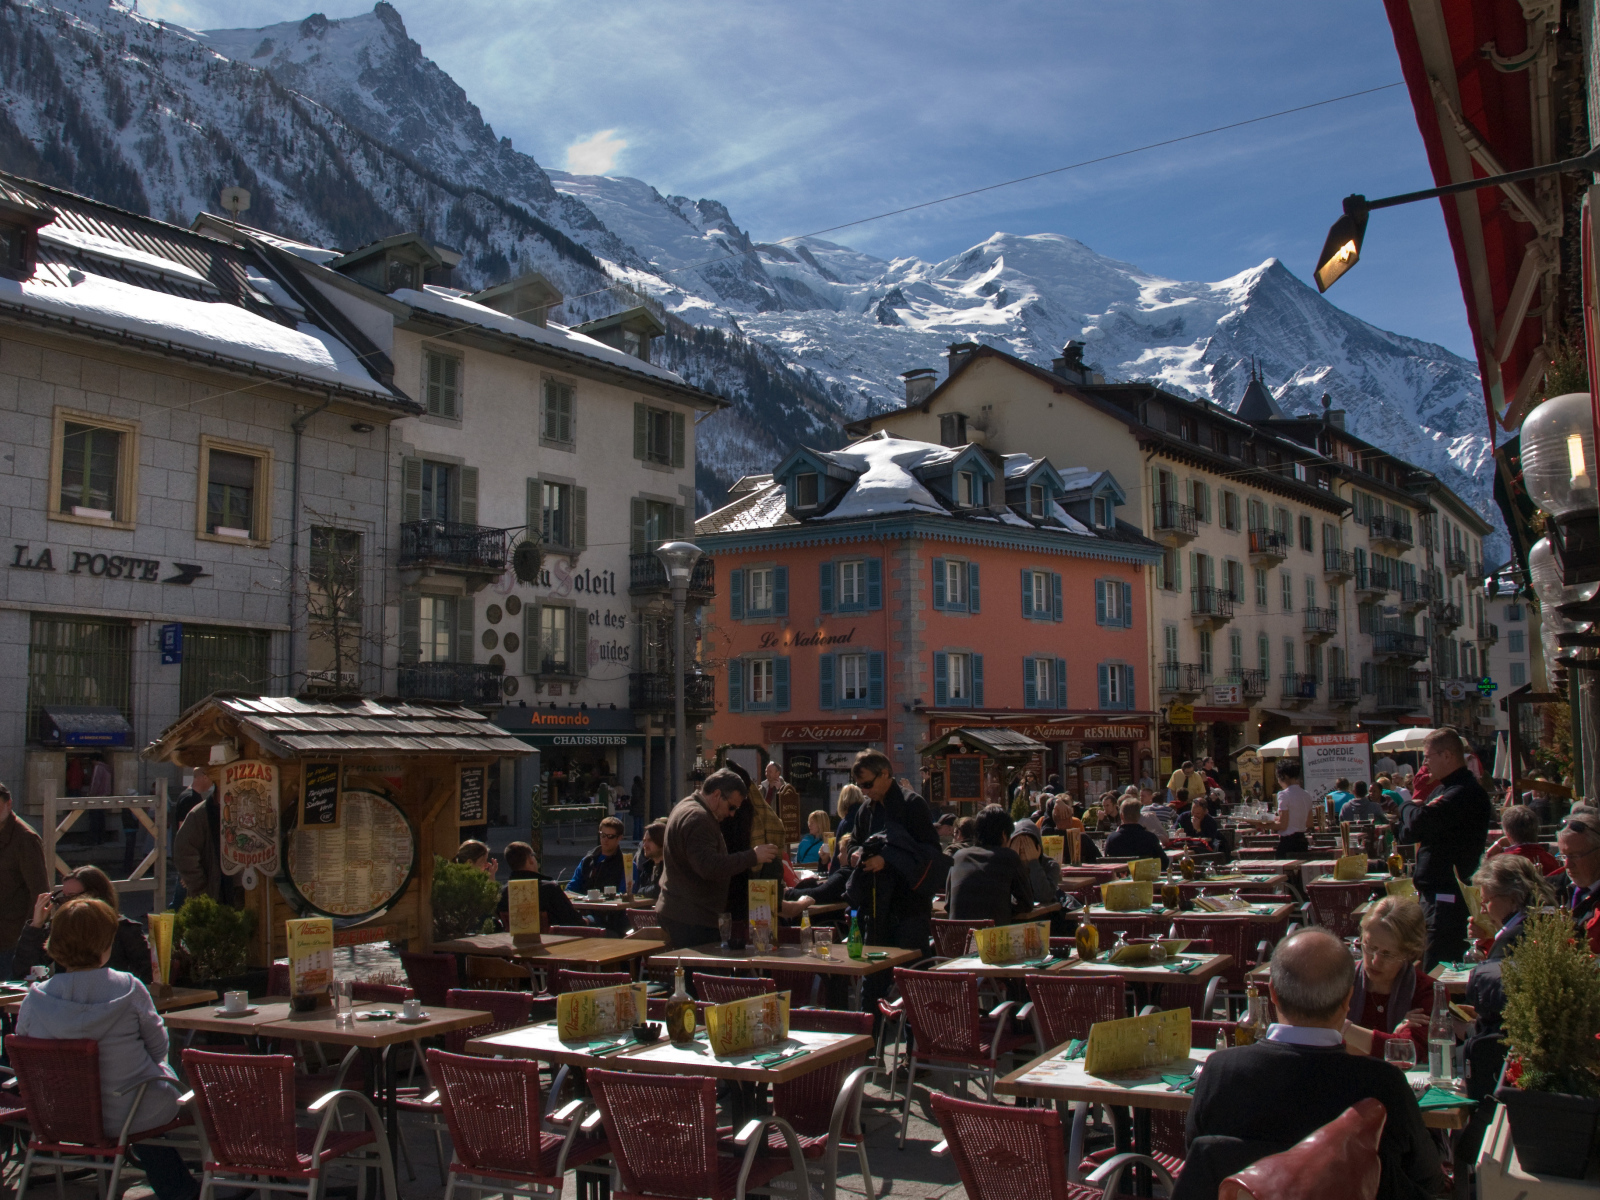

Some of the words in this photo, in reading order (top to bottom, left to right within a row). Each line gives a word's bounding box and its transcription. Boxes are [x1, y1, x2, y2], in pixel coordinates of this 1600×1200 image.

[10, 545, 56, 572] LA
[69, 551, 160, 582] POSTE
[588, 610, 599, 626] et
[605, 609, 627, 630] des
[758, 631, 779, 649] Le
[784, 627, 856, 647] National
[531, 711, 590, 725] Armando
[553, 736, 627, 745] CHAUSSURES
[781, 727, 794, 738] le
[799, 725, 868, 740] National
[1023, 727, 1030, 736] le
[1033, 726, 1074, 739] National
[1084, 726, 1144, 738] RESTAURANT
[1316, 747, 1354, 756] COMEDIE
[226, 763, 272, 784] PIZZAS
[233, 845, 275, 868] emporter
[334, 927, 385, 947] ZERIA
